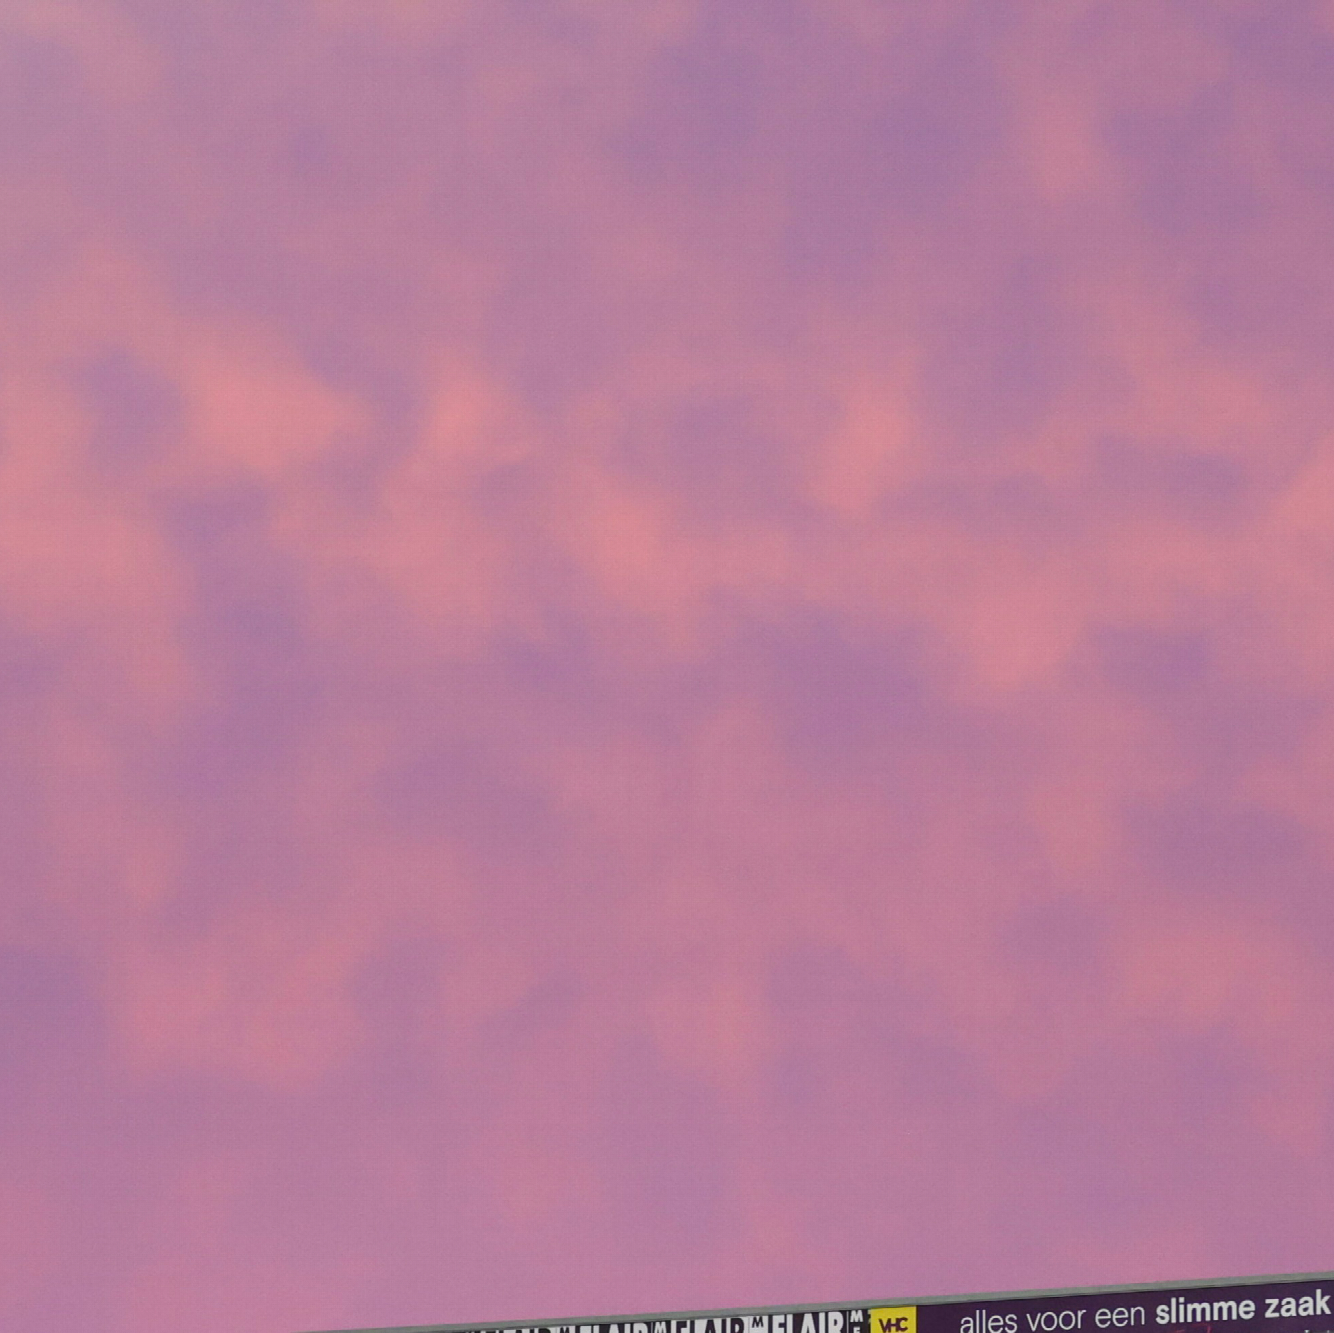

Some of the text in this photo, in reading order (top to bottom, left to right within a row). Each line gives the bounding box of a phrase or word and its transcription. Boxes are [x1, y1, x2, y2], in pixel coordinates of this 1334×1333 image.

[878, 1317, 908, 1333] VHC
[1026, 1307, 1084, 1333] voor
[1095, 1305, 1145, 1328] een
[1155, 1296, 1256, 1326] slimme
[1264, 1289, 1332, 1318] zaak
